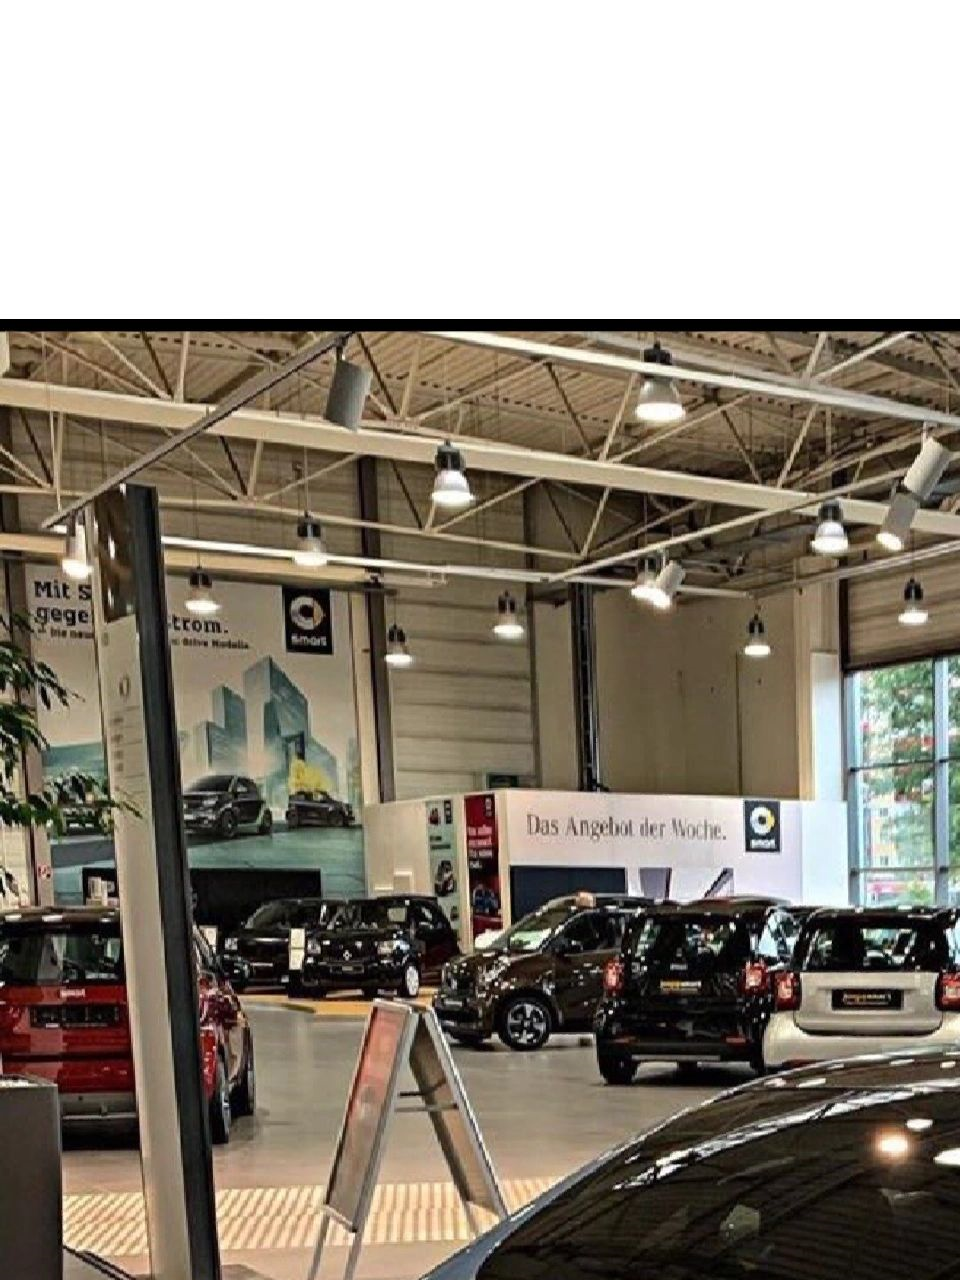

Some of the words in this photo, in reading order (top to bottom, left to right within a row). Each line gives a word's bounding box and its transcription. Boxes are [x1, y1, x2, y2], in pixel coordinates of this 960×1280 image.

[34, 579, 71, 600] Mit
[78, 584, 93, 600] S
[35, 606, 89, 627] gege
[168, 613, 229, 634] trom.
[291, 633, 328, 647] smart
[526, 813, 560, 837] Das
[565, 816, 635, 844] Angebot
[639, 817, 667, 838] der
[671, 818, 728, 842] Woche.
